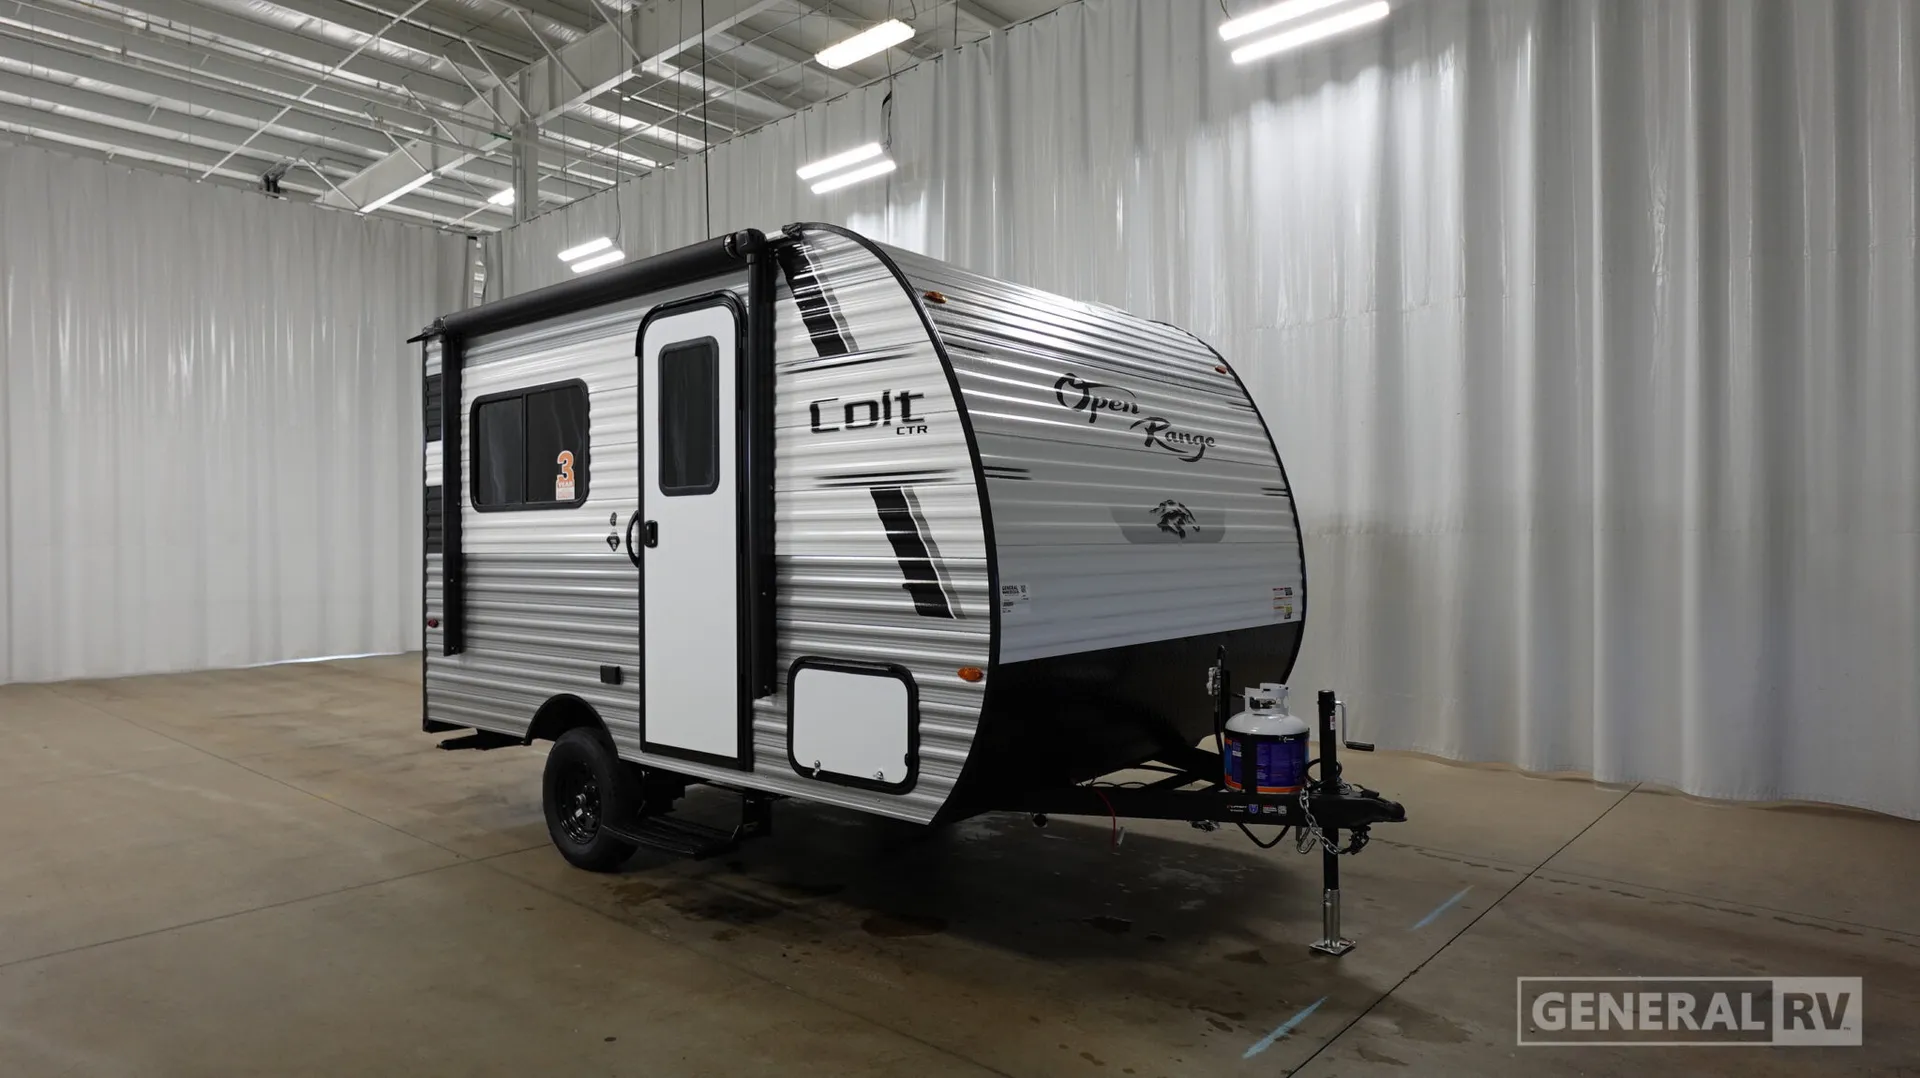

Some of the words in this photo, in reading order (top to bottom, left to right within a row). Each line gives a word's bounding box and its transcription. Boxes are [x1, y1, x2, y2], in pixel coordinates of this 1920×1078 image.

[809, 388, 925, 434] Colt
[1054, 372, 1140, 424] Open
[896, 425, 928, 435] CTR
[1130, 416, 1216, 463] Range
[557, 450, 574, 482] 3
